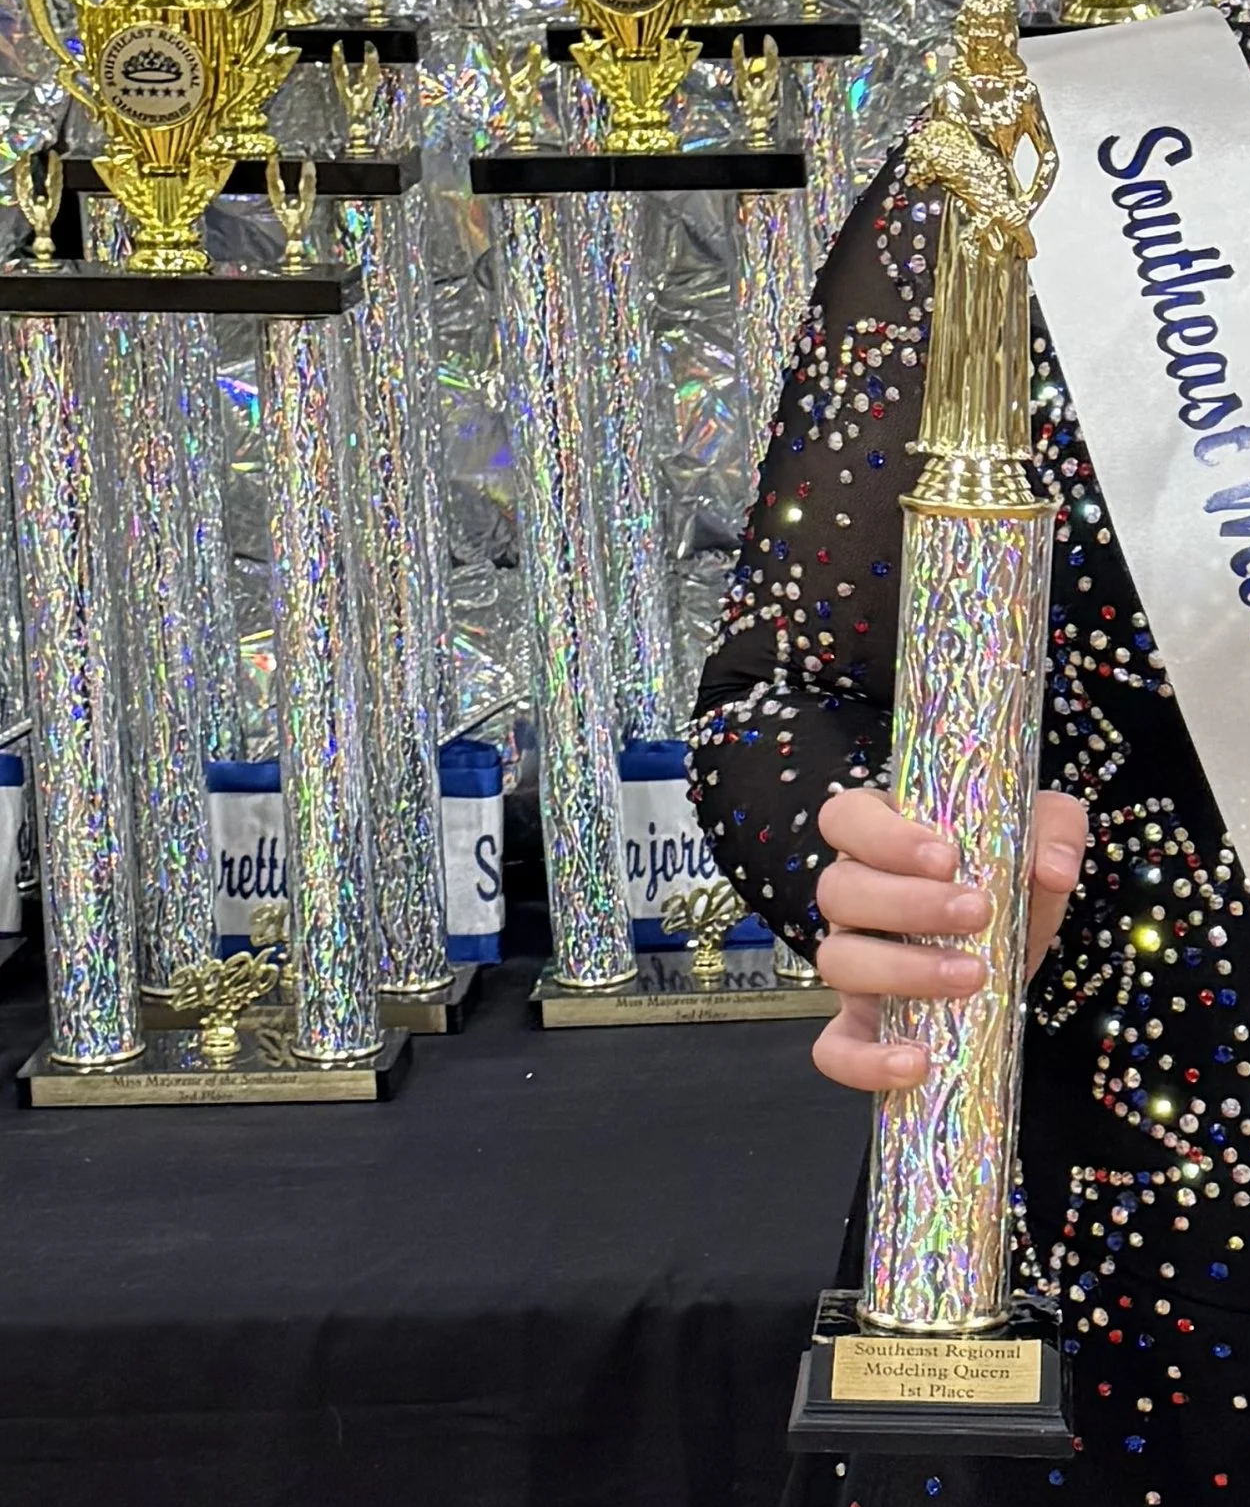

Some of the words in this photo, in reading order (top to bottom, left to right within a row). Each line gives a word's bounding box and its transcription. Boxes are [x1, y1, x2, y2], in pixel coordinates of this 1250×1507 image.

[626, 822, 716, 902] ajore
[854, 1342, 939, 1358] Southeast
[945, 1342, 1022, 1361] Regional
[864, 1362, 949, 1380] Modeling
[953, 1364, 1011, 1380] Queen
[899, 1383, 922, 1398] 1st
[929, 1384, 975, 1399] Place
